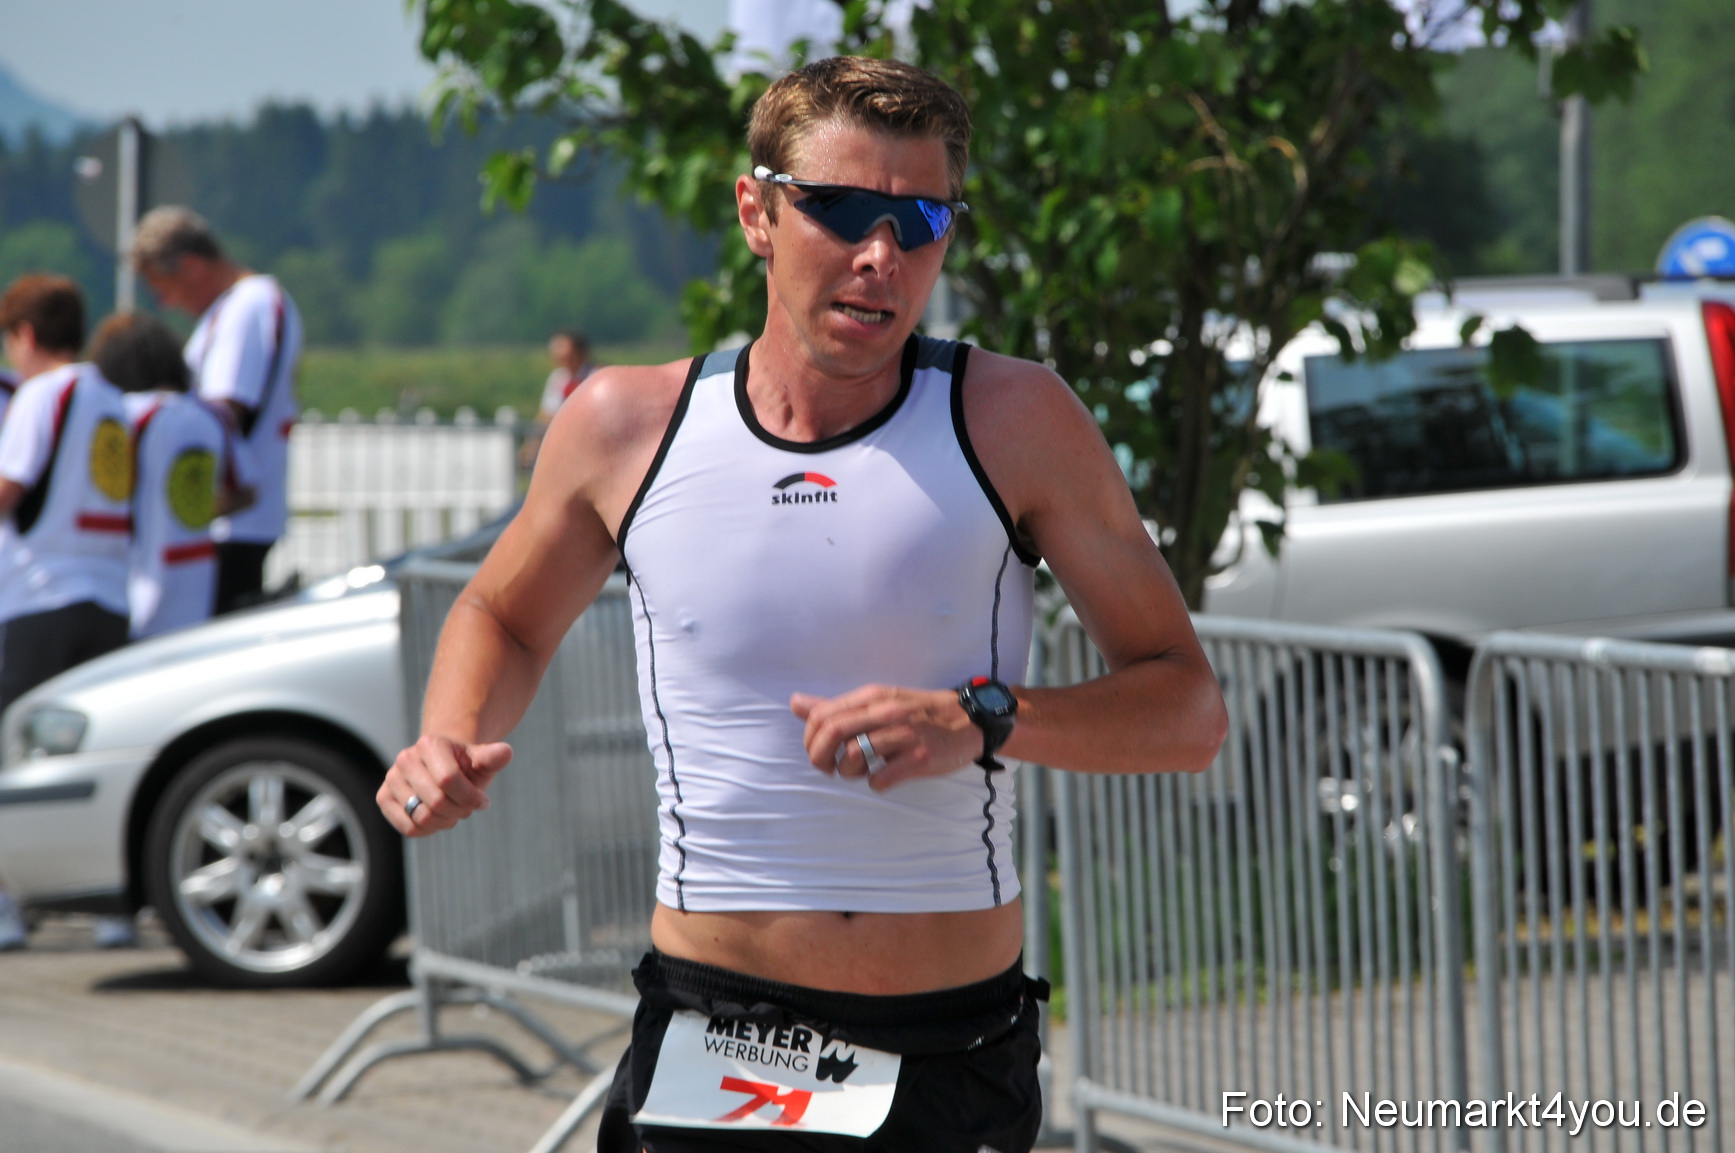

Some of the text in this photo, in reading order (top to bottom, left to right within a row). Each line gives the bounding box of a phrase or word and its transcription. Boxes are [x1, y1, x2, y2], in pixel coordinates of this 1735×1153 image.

[771, 490, 838, 505] skinfit
[705, 1017, 813, 1053] MEYER
[704, 1036, 809, 1073] WERBUNG
